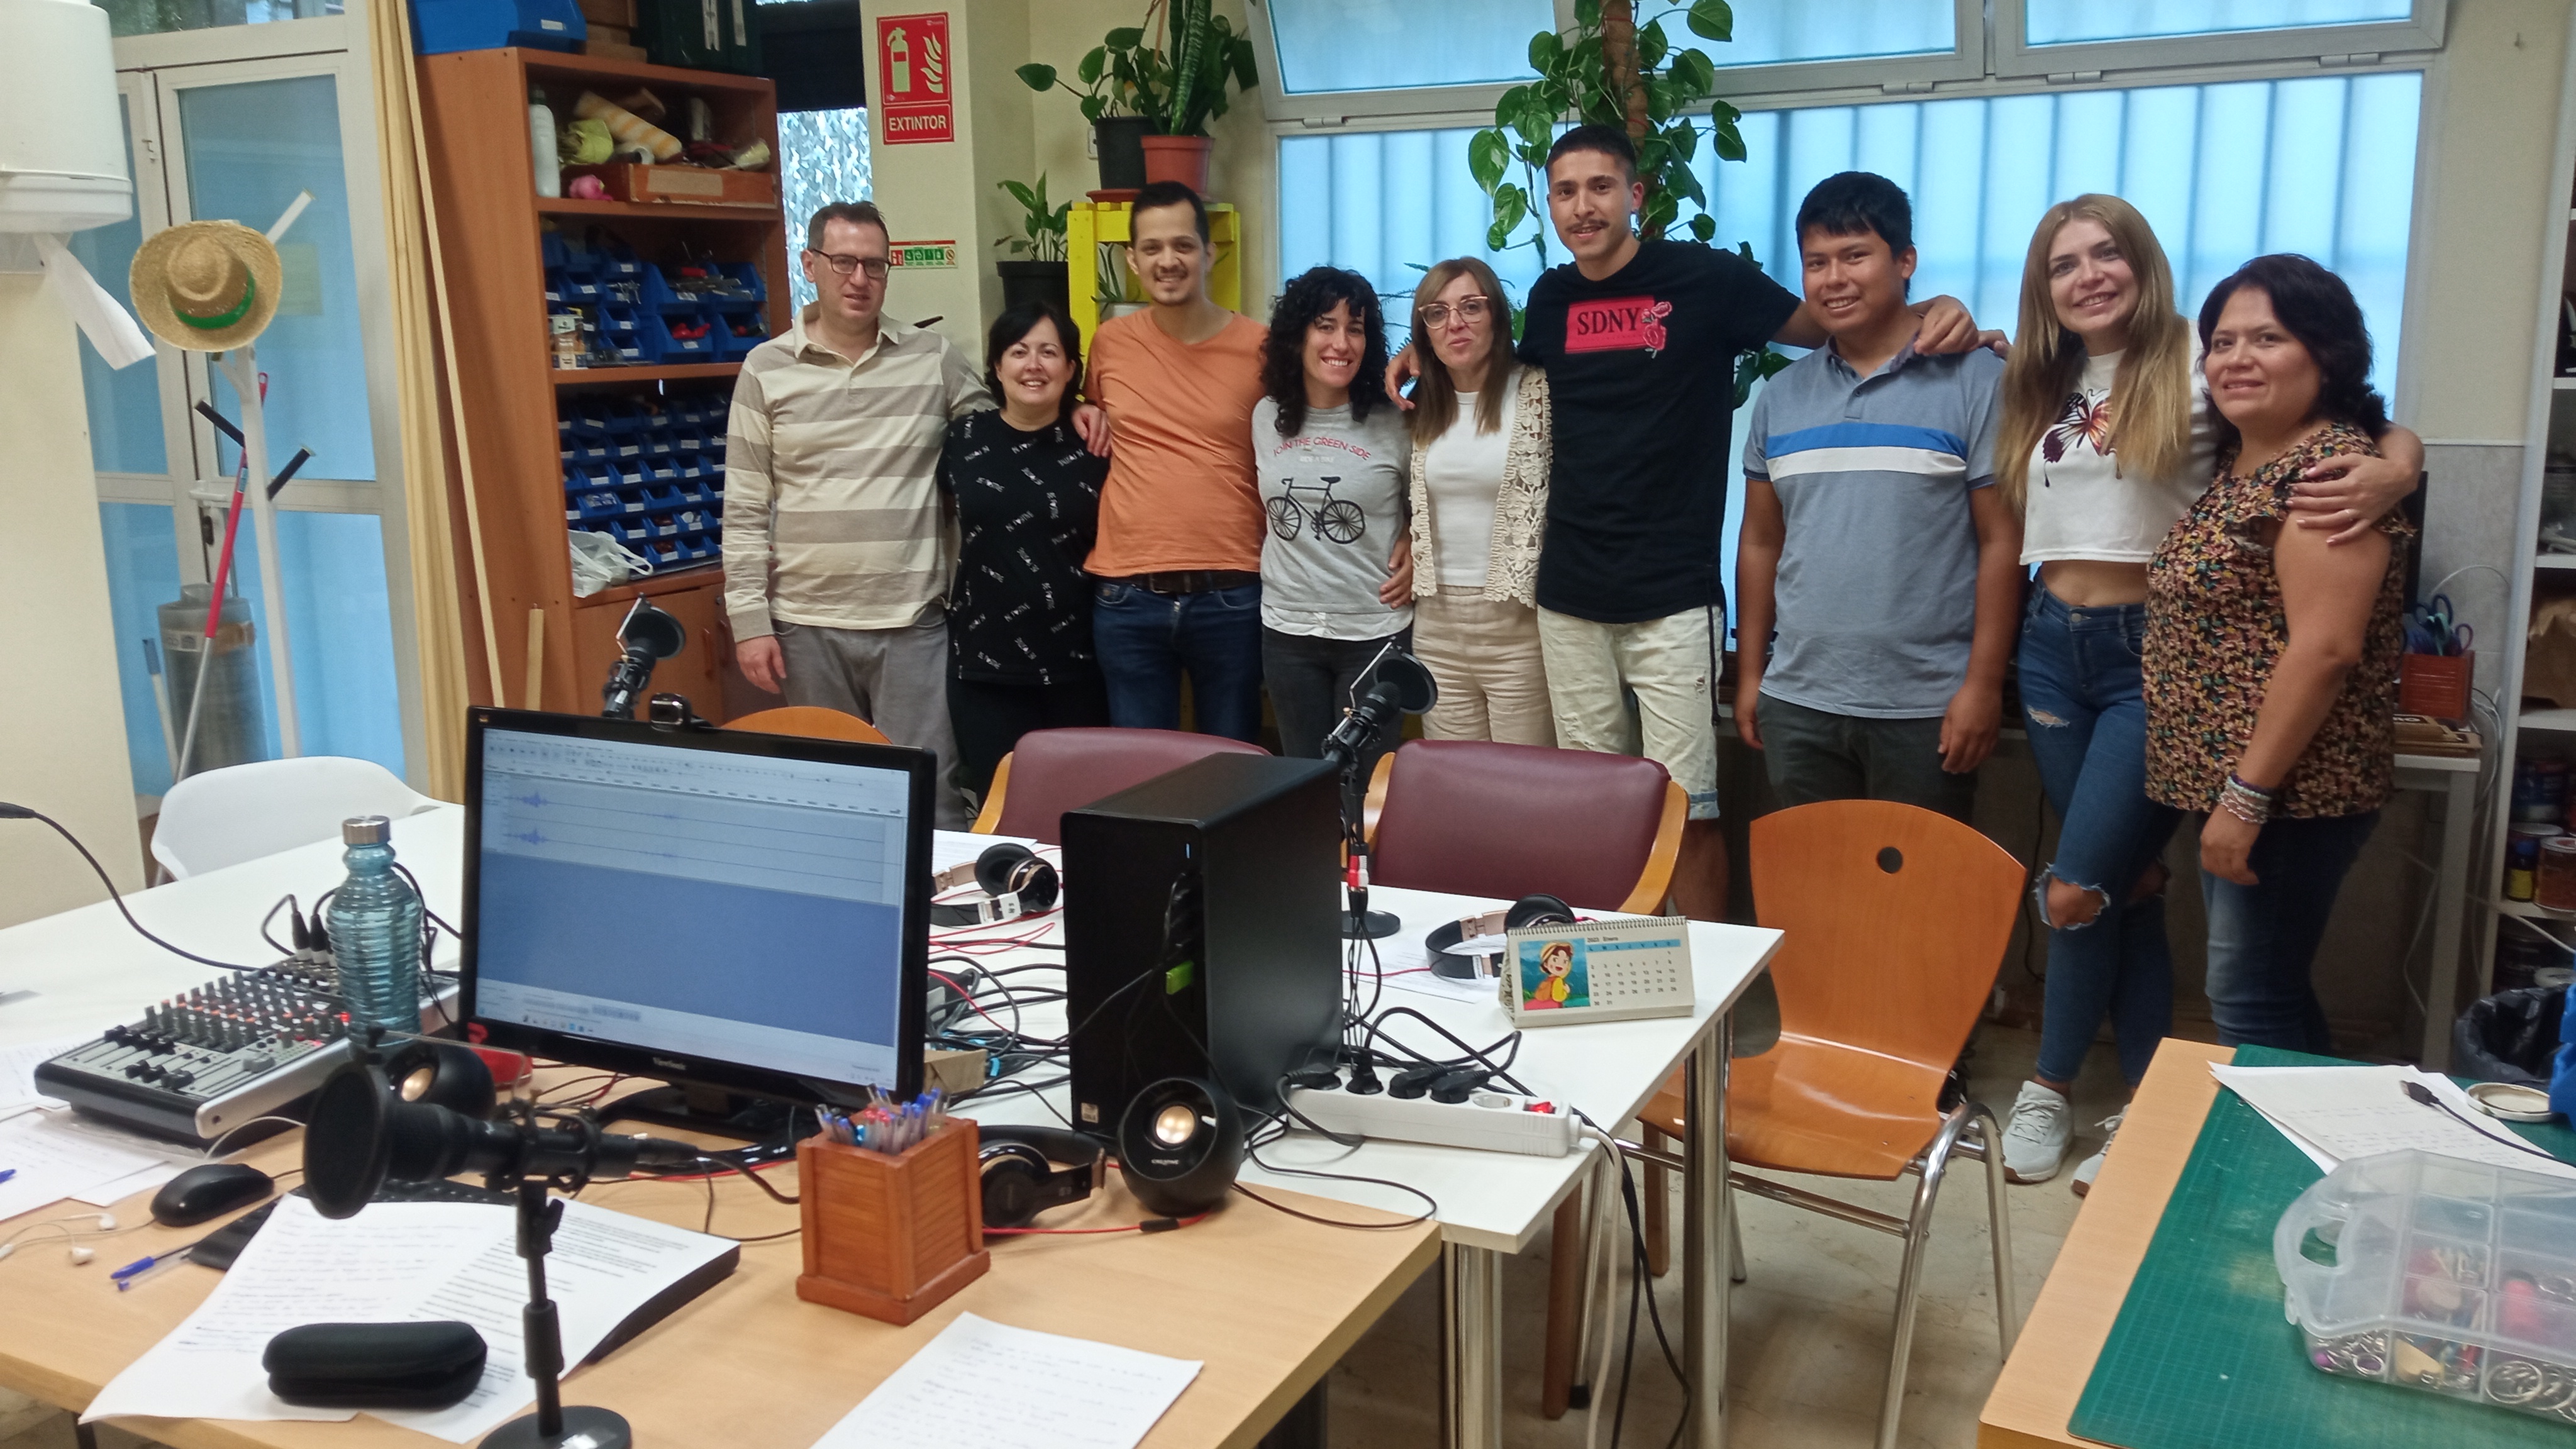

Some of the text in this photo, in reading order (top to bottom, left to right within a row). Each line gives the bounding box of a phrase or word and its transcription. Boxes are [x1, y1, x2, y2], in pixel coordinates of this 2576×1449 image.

[889, 115, 947, 131] EXTINTOR
[1577, 307, 1640, 335] SDNY
[1295, 437, 1311, 447] THE
[1313, 437, 1348, 450] GREEN
[1349, 445, 1371, 460] SIDE
